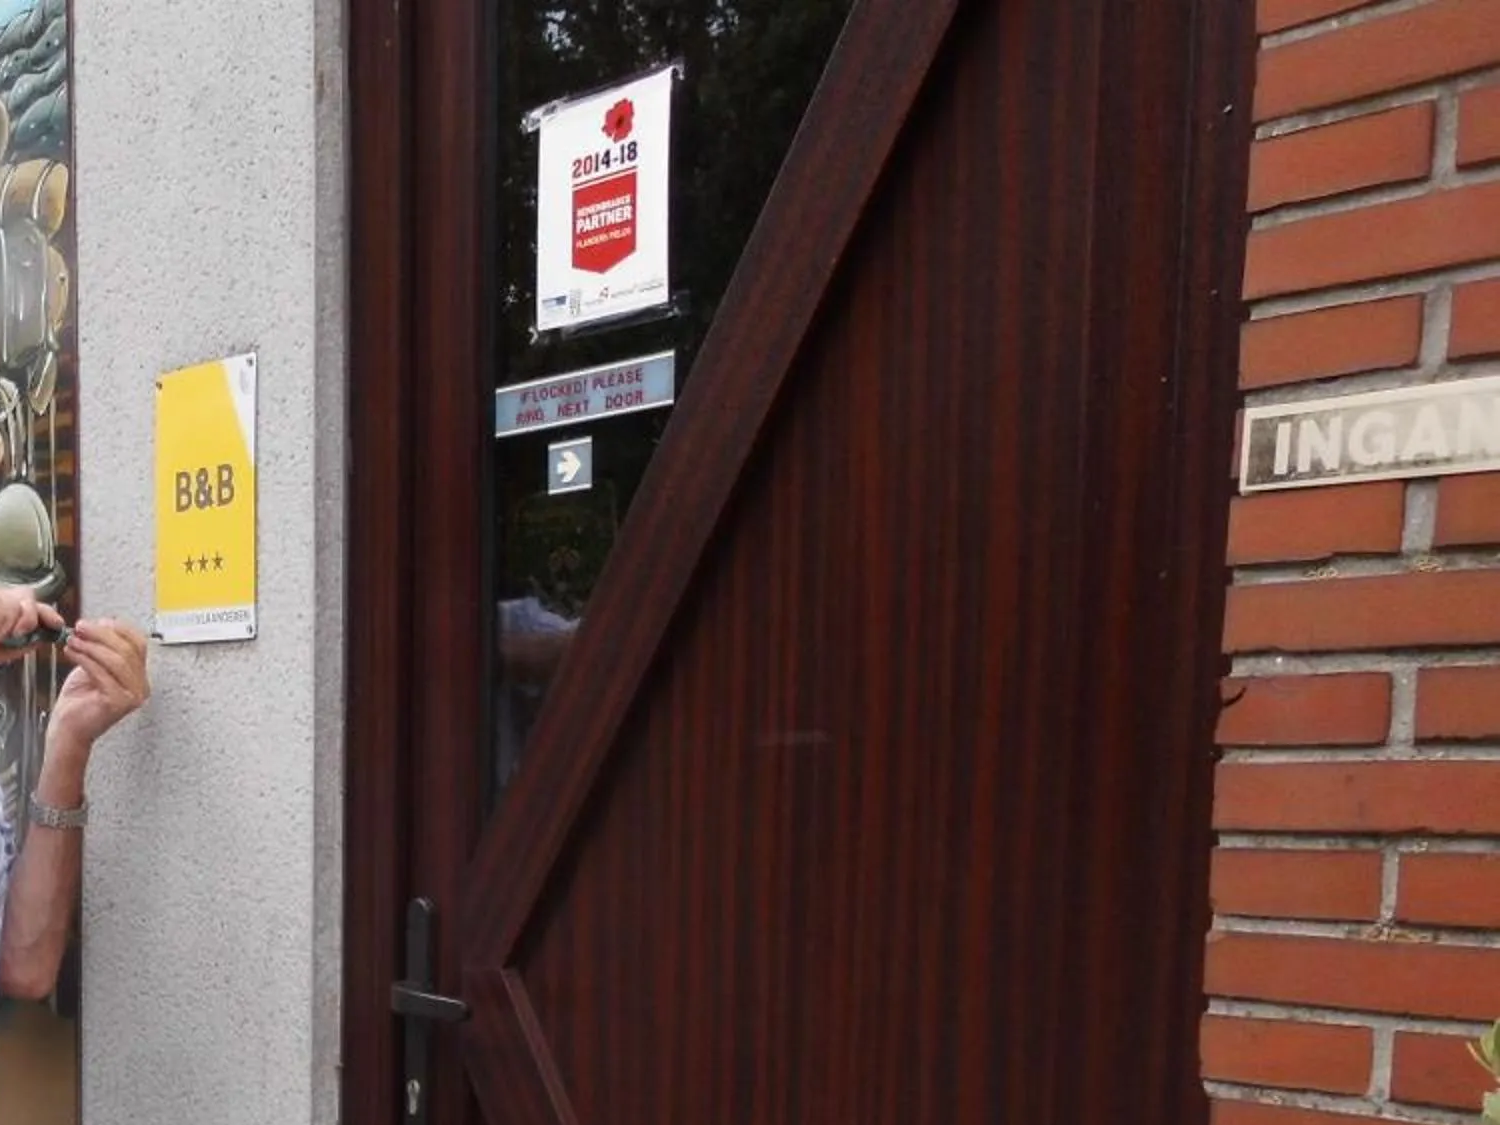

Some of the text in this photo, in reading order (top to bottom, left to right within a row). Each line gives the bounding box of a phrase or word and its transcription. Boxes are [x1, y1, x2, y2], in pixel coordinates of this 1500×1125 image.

[572, 141, 638, 178] 2014-18
[576, 205, 633, 234] PARTNER
[592, 368, 643, 390] PLEASE
[557, 399, 589, 417] NEXT
[605, 389, 644, 409] DOOR
[175, 463, 235, 512] B&B
